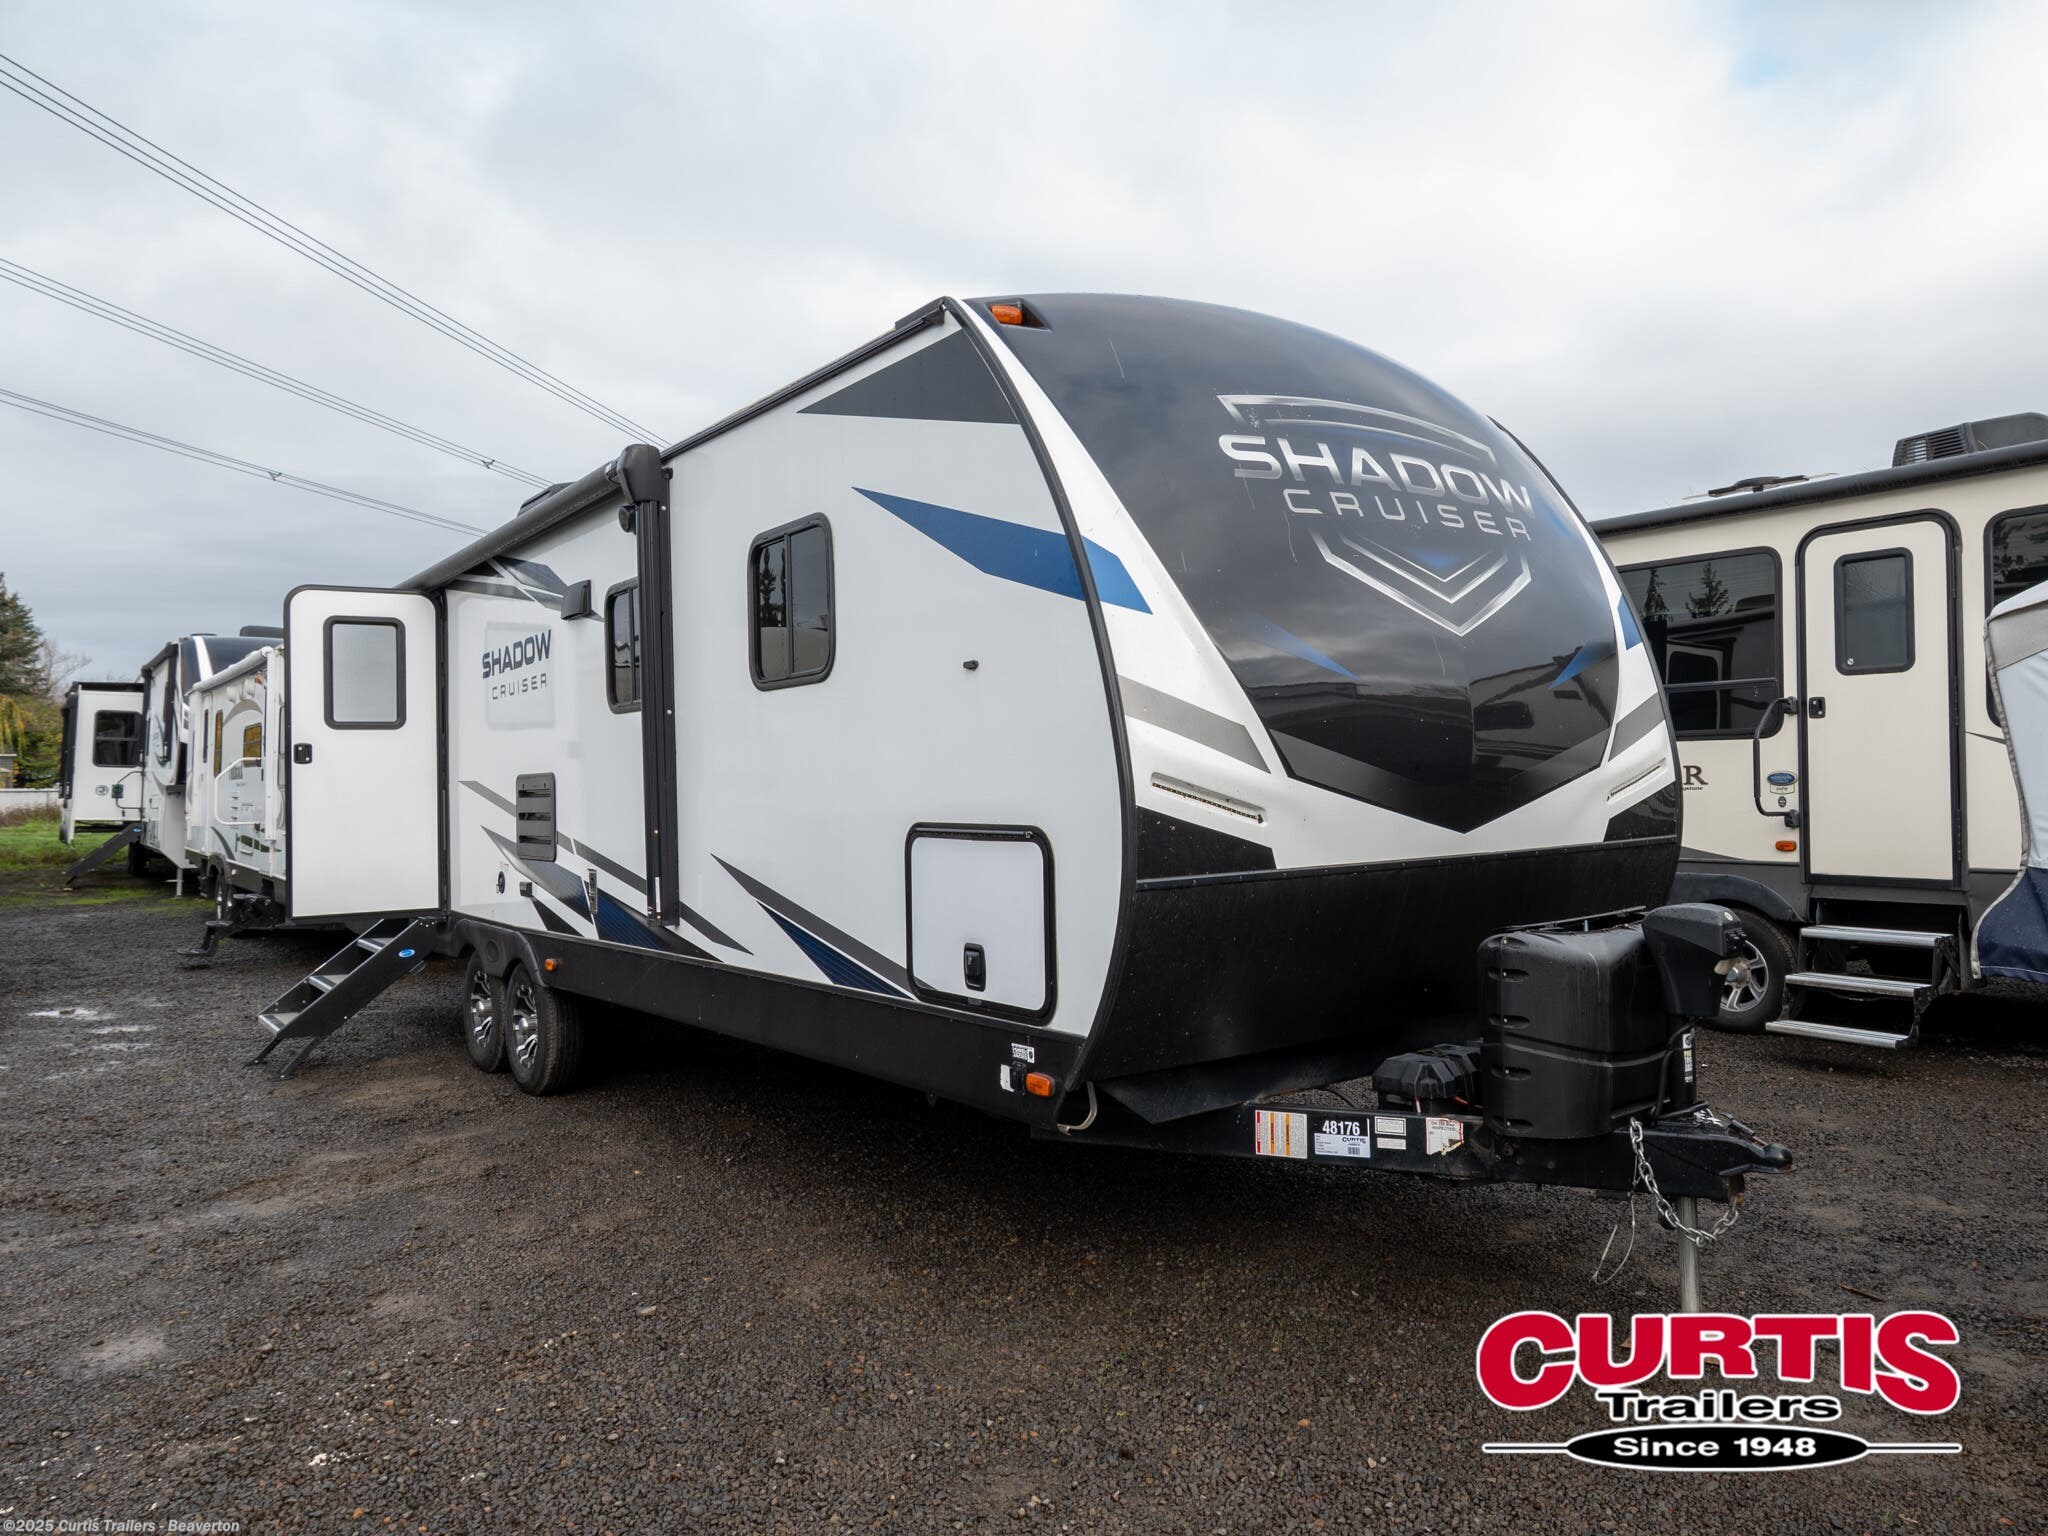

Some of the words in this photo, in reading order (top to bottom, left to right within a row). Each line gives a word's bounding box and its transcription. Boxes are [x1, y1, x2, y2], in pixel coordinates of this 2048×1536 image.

[1218, 434, 1535, 517] SHADOW
[1283, 488, 1532, 541] CRUISER
[482, 629, 552, 679] SHADOW
[492, 673, 548, 700] CRUISER
[1322, 1120, 1361, 1136] 48176
